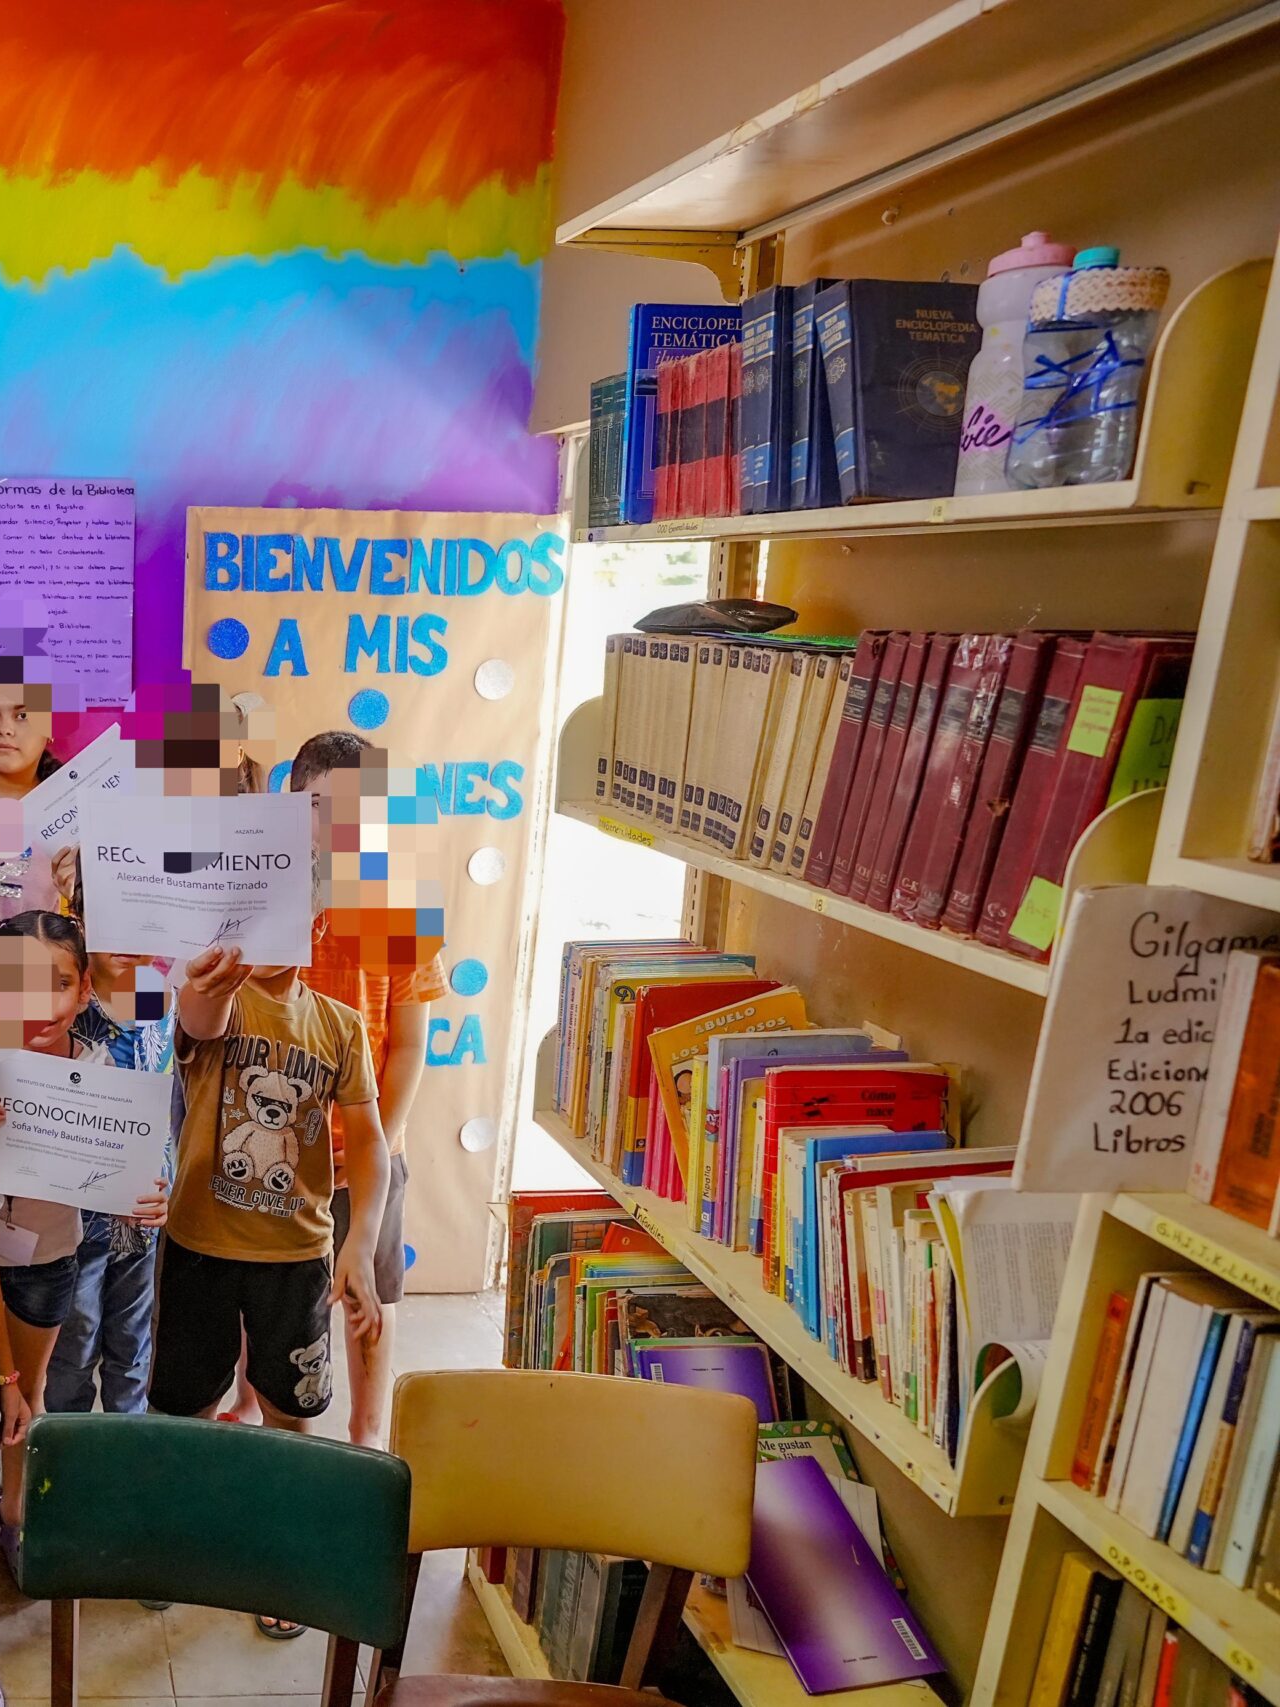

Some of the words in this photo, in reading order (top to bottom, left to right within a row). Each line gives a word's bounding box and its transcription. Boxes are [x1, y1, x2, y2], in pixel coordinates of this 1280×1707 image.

[652, 316, 742, 331] ENCICLOPED
[895, 319, 977, 332] ENCICLOPEDIA
[915, 308, 954, 319] NUEVA
[49, 483, 66, 496] de
[72, 485, 83, 496] la
[203, 531, 566, 596] BIENVENIDOS
[263, 618, 310, 677] A
[344, 612, 449, 677] MIS
[116, 872, 165, 885] Alexander
[166, 876, 225, 891] Bustamante
[227, 880, 268, 891] Tiznado
[1129, 976, 1217, 1004] Ludmi
[695, 1007, 756, 1035] ABUELO
[1162, 1019, 1214, 1044] edic
[671, 1045, 700, 1060] LOS
[1109, 1090, 1186, 1116] 2006
[33, 1125, 59, 1139] Yanely
[60, 1131, 93, 1145] Bautista
[94, 1137, 124, 1150] Salazar
[1093, 1121, 1186, 1154] Libros
[209, 1175, 246, 1201] EVER
[251, 1190, 286, 1209] GIVE
[290, 1196, 306, 1211] UP
[758, 1440, 776, 1451] Me
[778, 1440, 812, 1453] gustan
